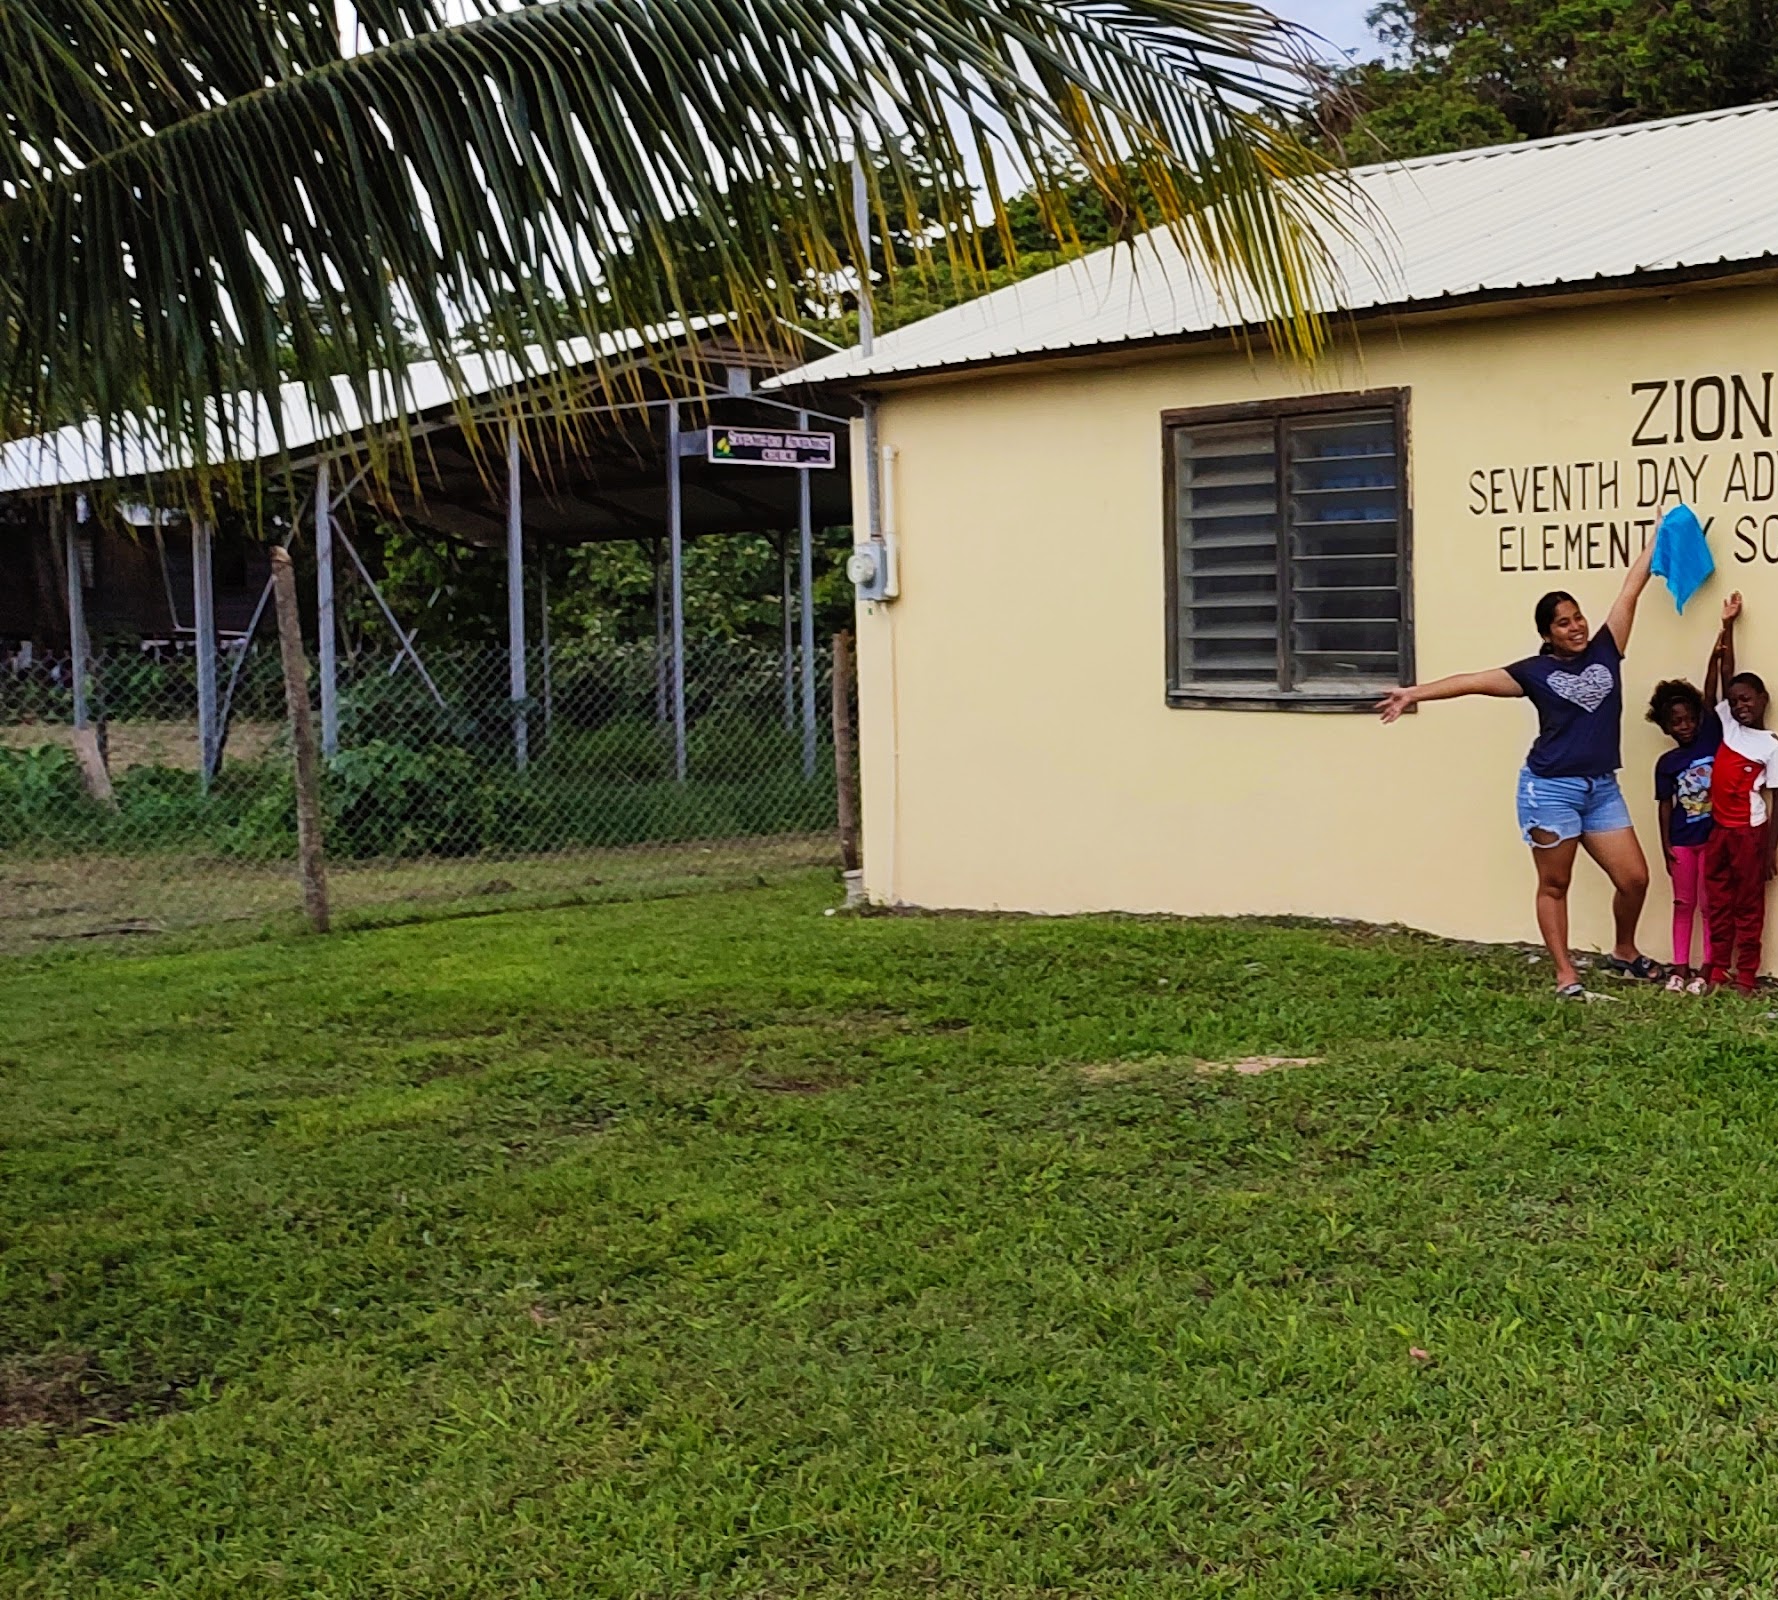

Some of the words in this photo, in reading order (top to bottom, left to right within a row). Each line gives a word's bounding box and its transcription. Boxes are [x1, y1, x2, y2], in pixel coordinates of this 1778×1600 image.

[1630, 372, 1775, 447] ZION
[1468, 460, 1619, 515] SEVENTH
[1636, 453, 1709, 508] DAY
[1499, 515, 1714, 572] ELEMENT
